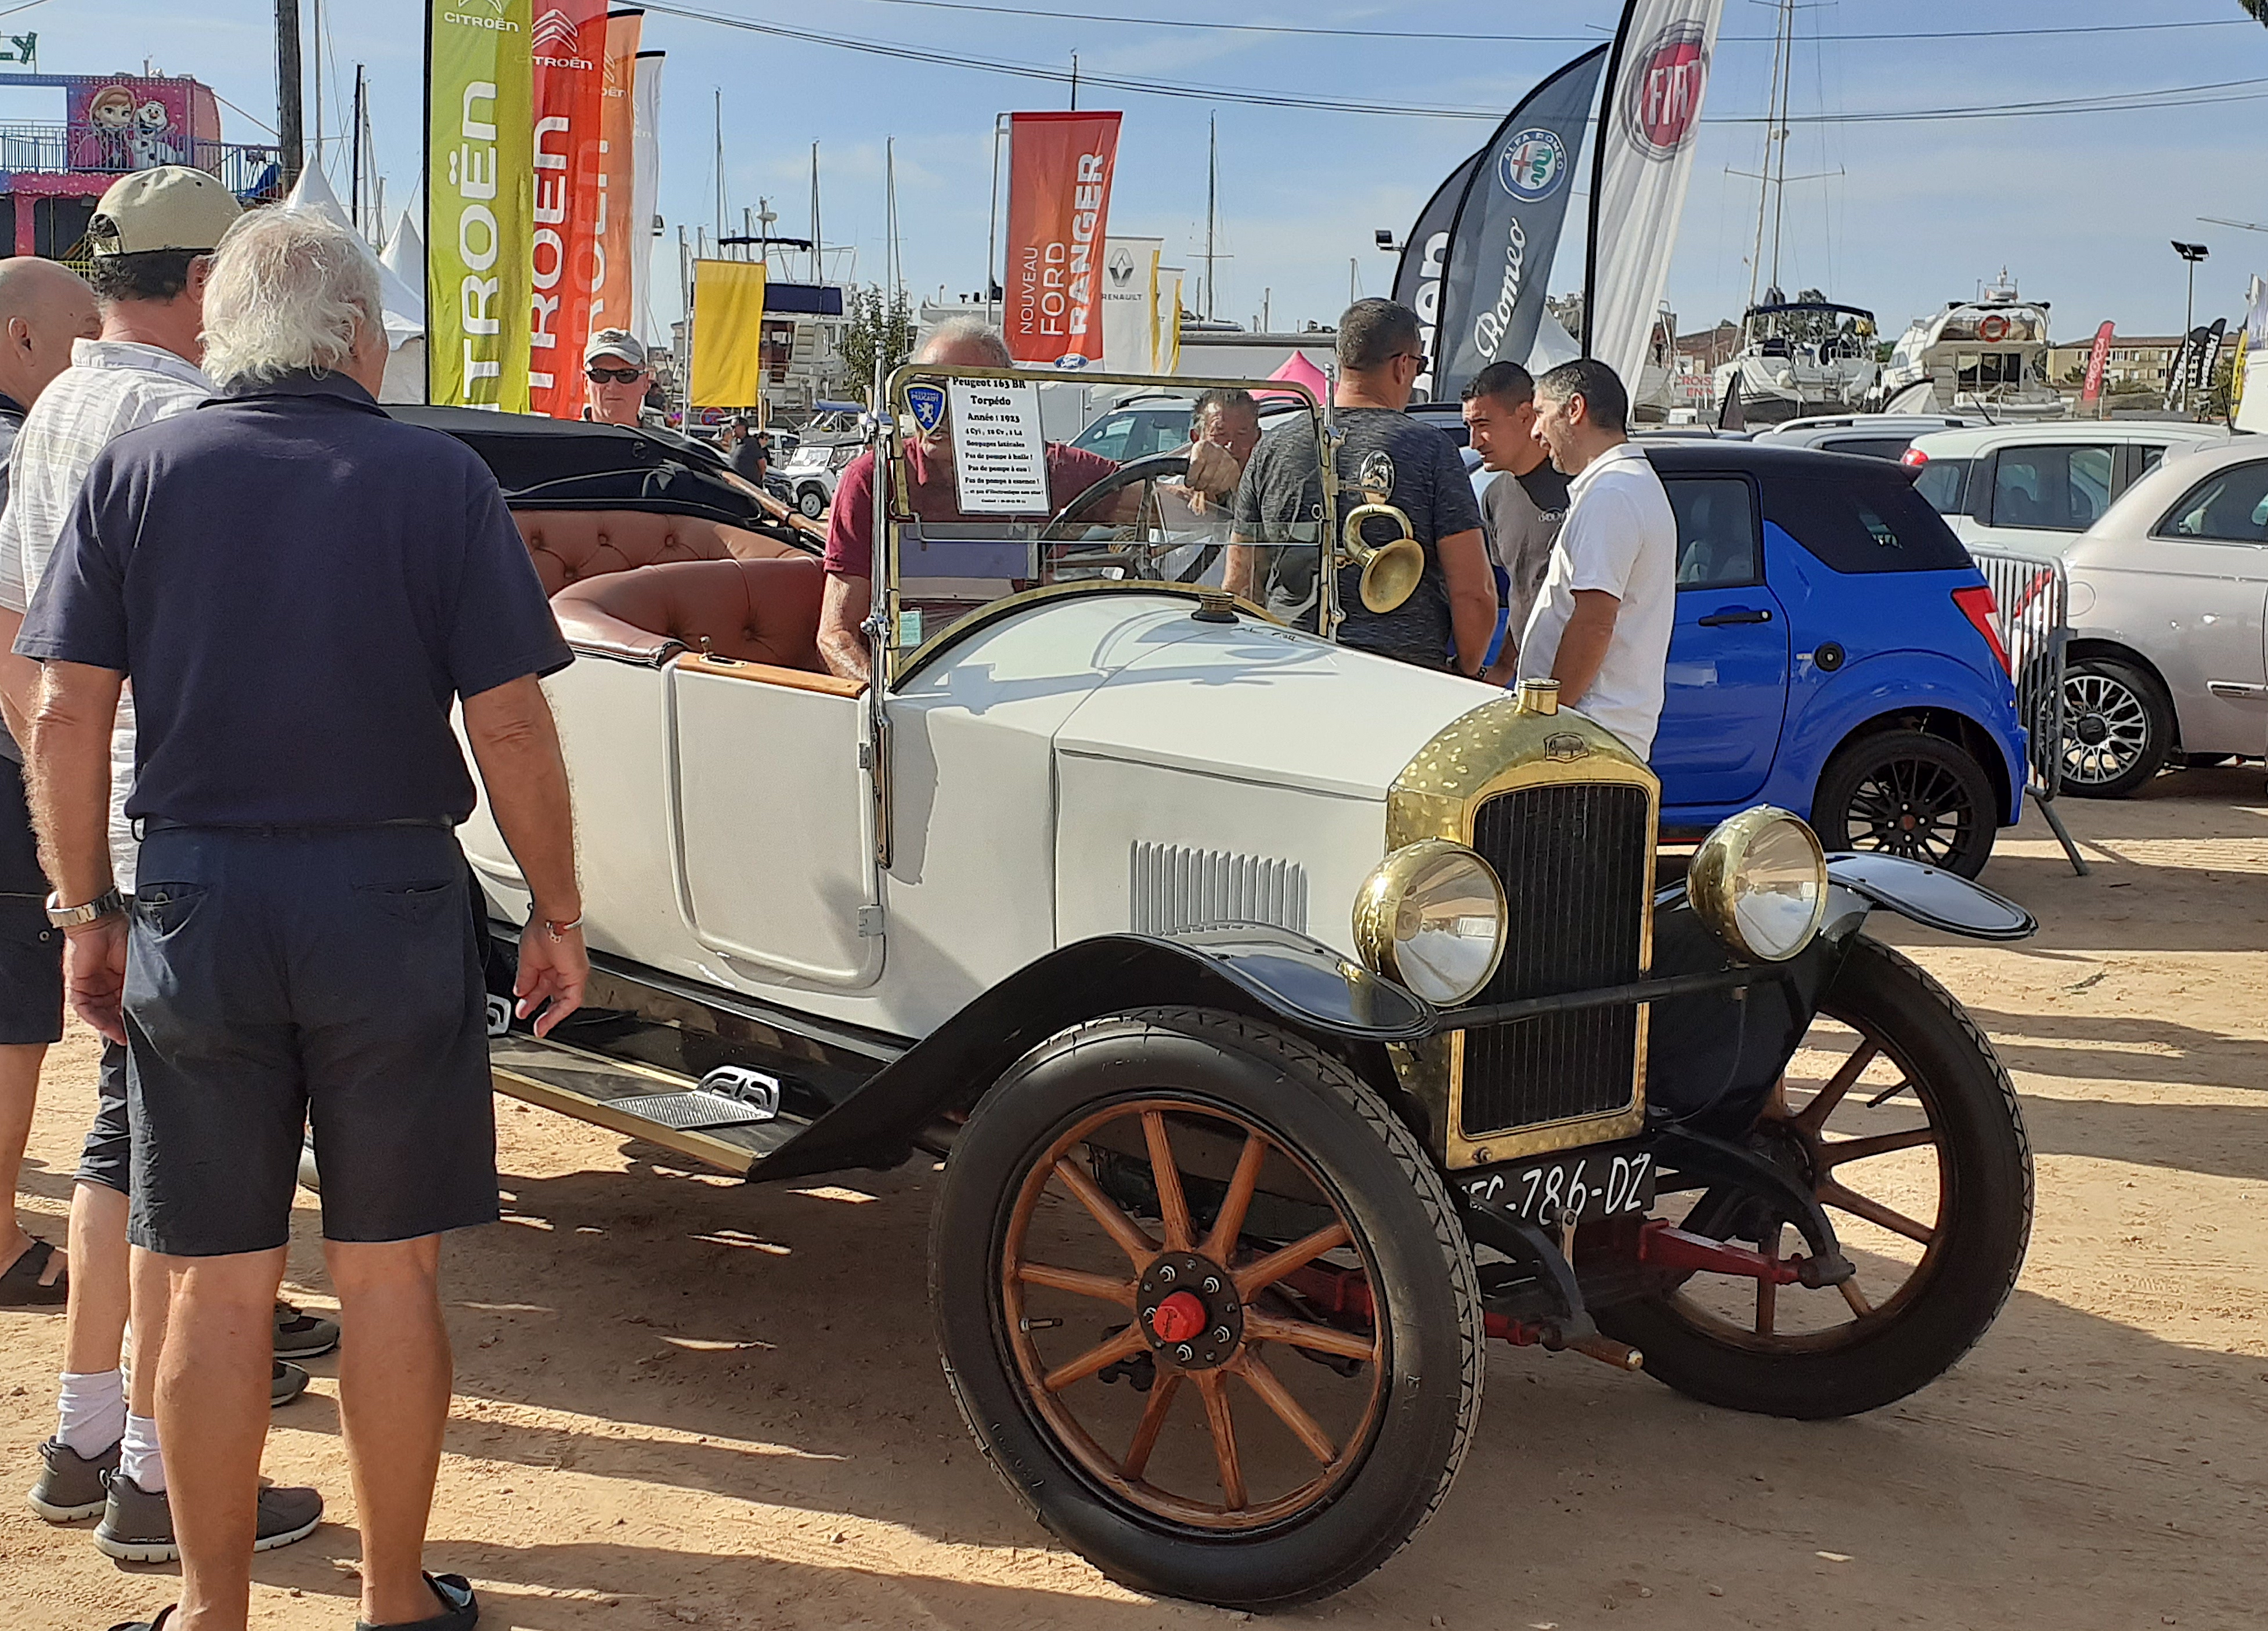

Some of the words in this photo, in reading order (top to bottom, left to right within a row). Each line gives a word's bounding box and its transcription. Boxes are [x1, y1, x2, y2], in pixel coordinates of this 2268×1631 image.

[1648, 59, 1701, 125] FIAT
[1504, 133, 1530, 162] ALFA
[1536, 132, 1564, 171] ROMEO
[1068, 153, 1104, 335] RANGER
[1020, 247, 1039, 335] NOUVEAU
[1039, 241, 1066, 335] FORD
[1474, 216, 1526, 364] Romeo
[952, 377, 991, 389] Peugeot
[994, 379, 1010, 389] 163
[1012, 379, 1026, 389] BR
[970, 395, 1011, 407] Torpédo
[967, 413, 994, 422] Année
[1001, 415, 1020, 423] 1923
